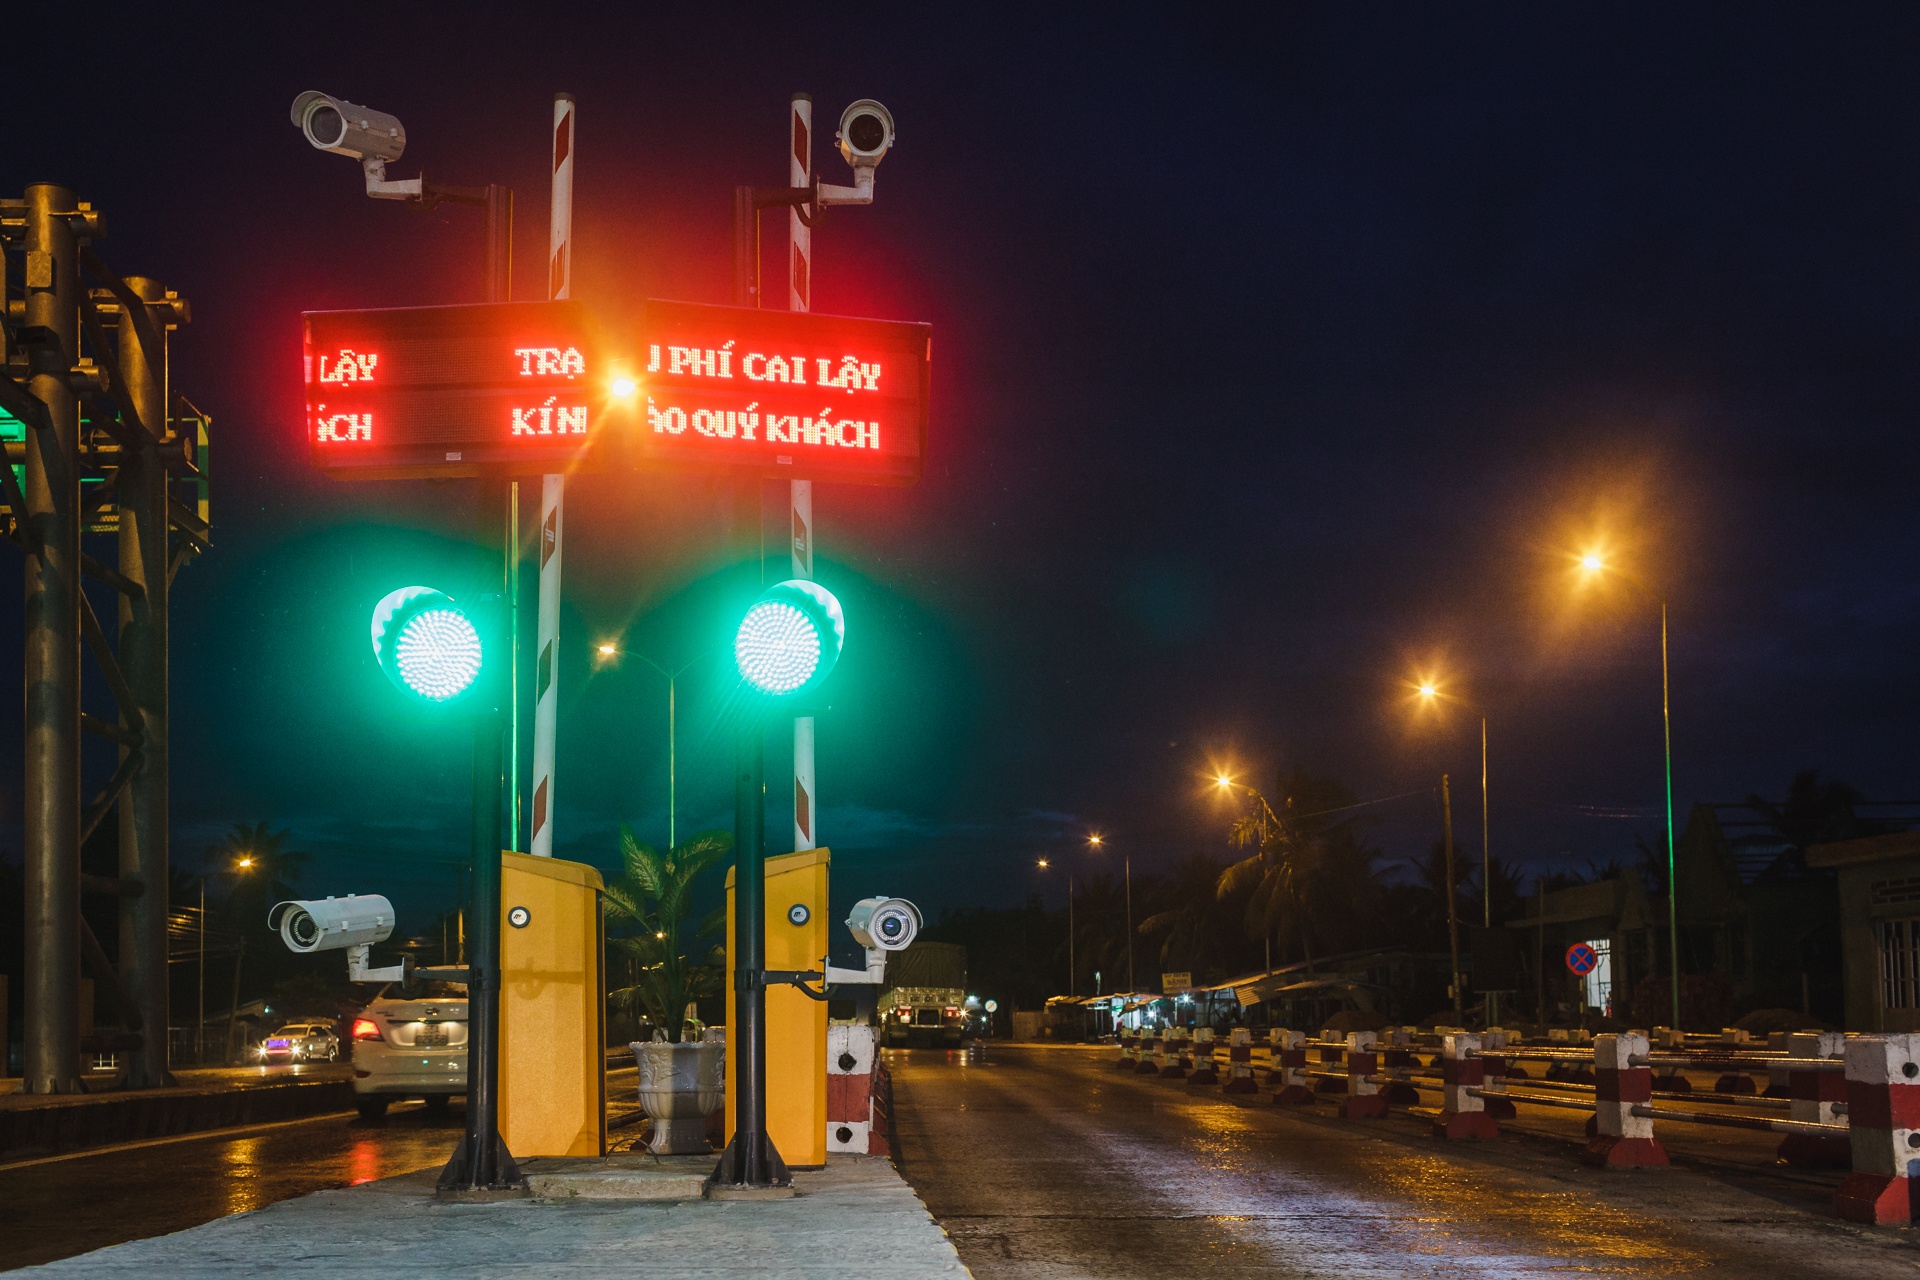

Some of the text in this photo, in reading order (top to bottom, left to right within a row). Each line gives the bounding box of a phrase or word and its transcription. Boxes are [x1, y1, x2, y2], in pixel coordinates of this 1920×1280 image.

[514, 346, 586, 380] TRẠ
[668, 340, 735, 378] PHÍ
[743, 352, 806, 384] CAI
[816, 355, 881, 394] LẬY
[511, 395, 587, 436] KÍN
[692, 402, 759, 440] QUÝ
[766, 407, 880, 449] KHÁCH
